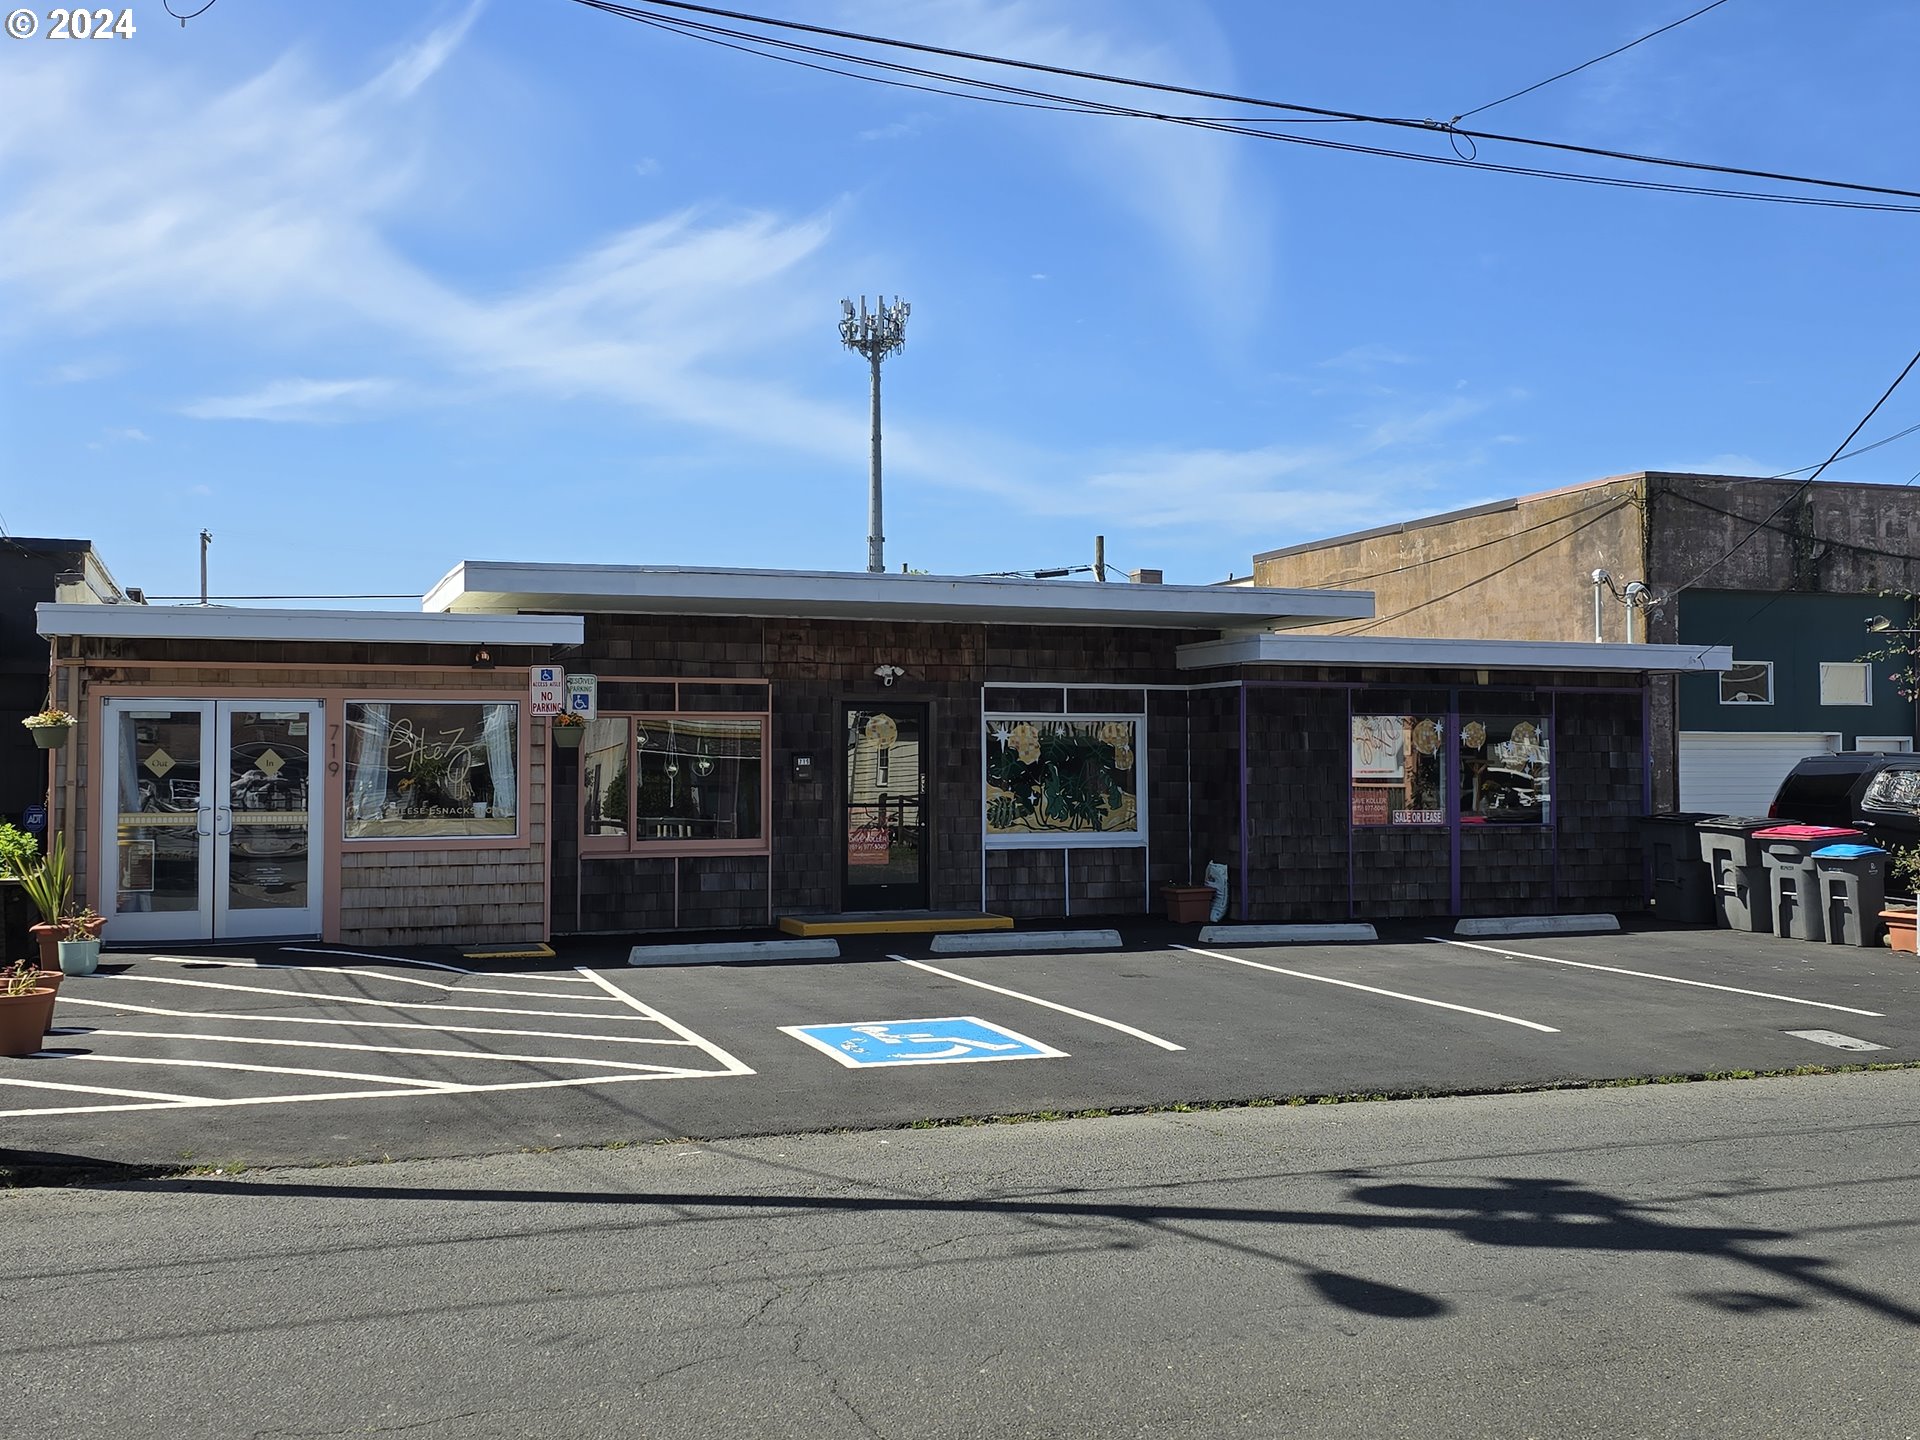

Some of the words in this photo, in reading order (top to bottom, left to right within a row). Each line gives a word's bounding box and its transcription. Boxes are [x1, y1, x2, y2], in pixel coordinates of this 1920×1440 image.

[541, 691, 553, 701] NO
[532, 702, 562, 713] PARKING
[328, 724, 340, 777] 719
[152, 759, 168, 767] Out
[265, 759, 274, 767] In
[27, 814, 43, 824] ADT
[1394, 812, 1411, 823] SALE
[1411, 812, 1421, 823] OR
[1422, 812, 1442, 823] LEASE
